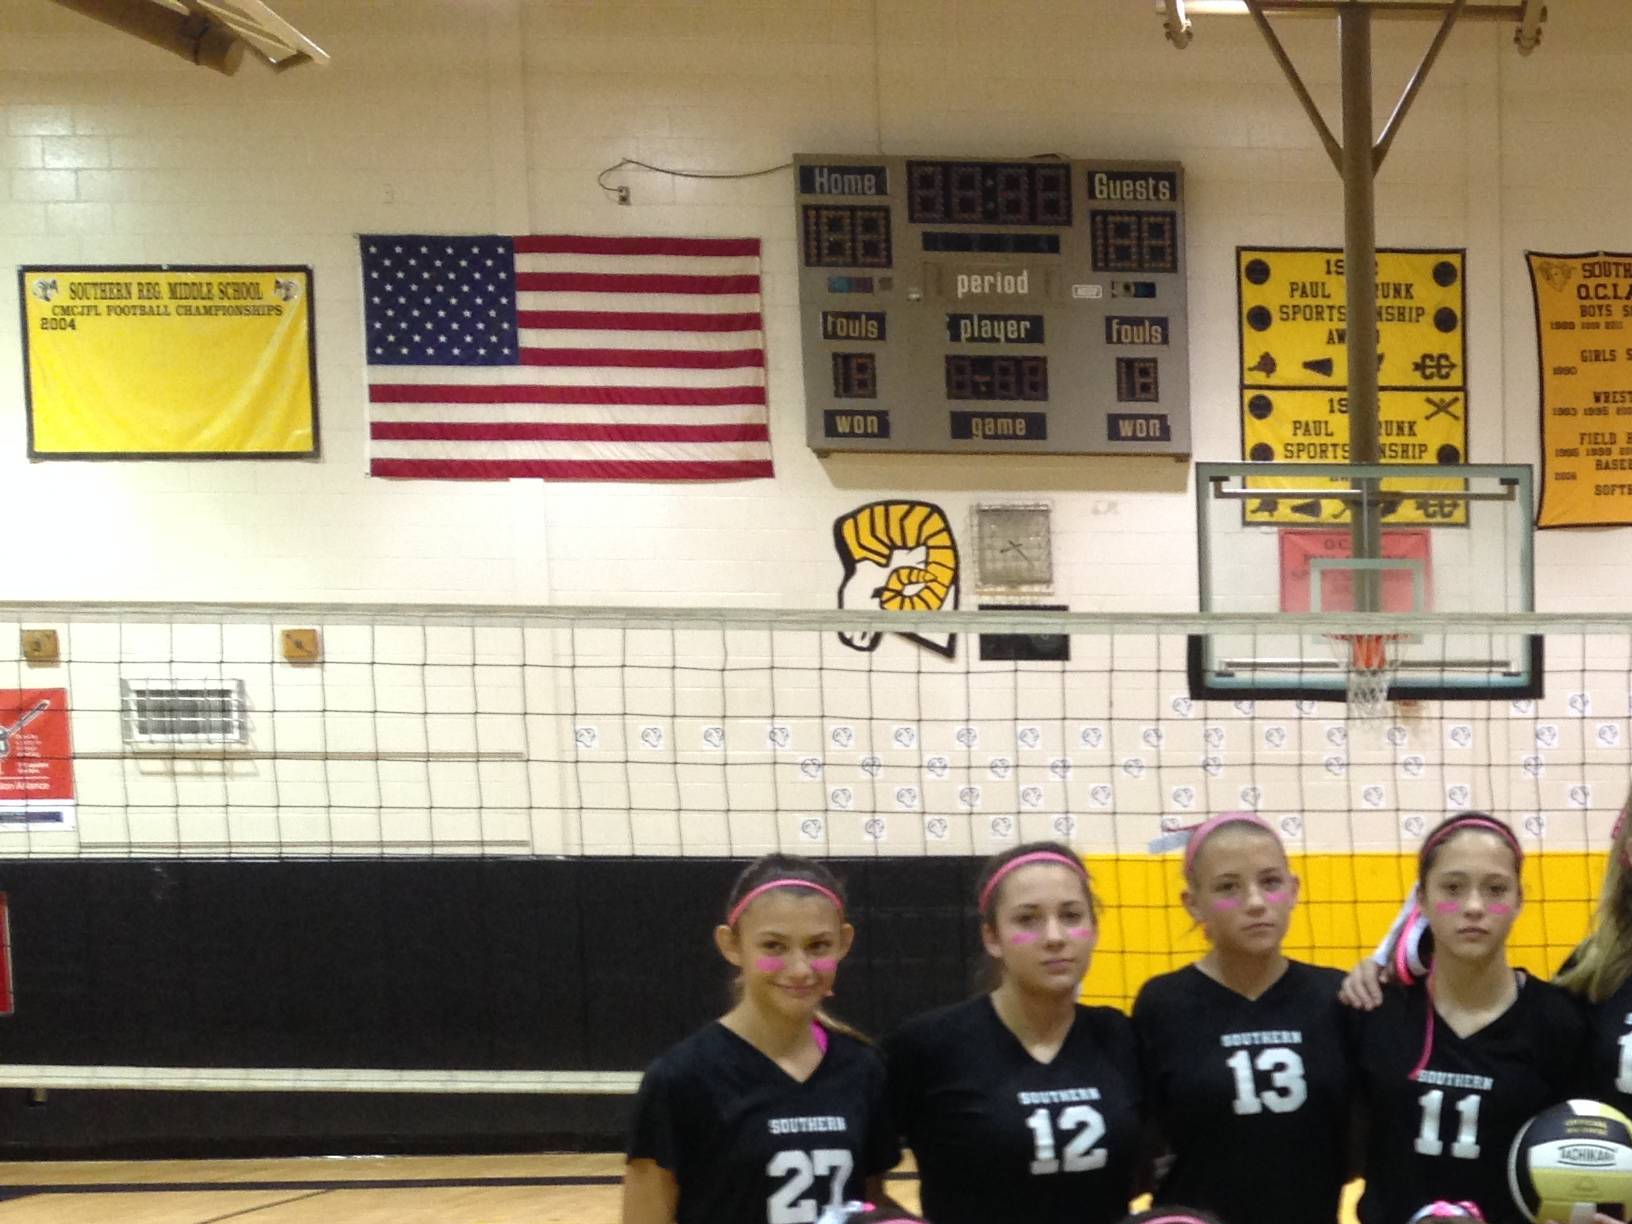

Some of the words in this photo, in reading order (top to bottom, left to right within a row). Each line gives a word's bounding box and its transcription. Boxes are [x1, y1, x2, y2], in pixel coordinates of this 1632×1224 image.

[813, 167, 877, 195] Home
[1094, 173, 1171, 200] Guests
[69, 281, 132, 300] SOUTHERN
[168, 282, 213, 299] MIDDLE
[218, 282, 263, 300] SCHOOL
[956, 270, 1029, 297] period
[1289, 282, 1331, 298] PAUL
[107, 304, 170, 316] FOOTBALL
[176, 304, 283, 316] CHAMPIONSHIPS
[1580, 304, 1613, 317] BOYS
[40, 318, 76, 331] 2004
[959, 316, 1031, 342] player
[1111, 319, 1162, 344] fouls
[1581, 349, 1616, 362] GIRLS
[835, 413, 879, 434] won
[971, 416, 1027, 438] game
[1119, 417, 1161, 437] won
[1292, 420, 1334, 437] PAUL
[1579, 432, 1617, 445] FIELD
[1221, 1030, 1303, 1047] SOUTHERN
[1226, 1047, 1307, 1115] 13
[1417, 1068, 1494, 1091] SOUTHERN
[1017, 1087, 1101, 1106] SOUTHERN
[768, 1116, 847, 1134] SOUTHERN
[1414, 1090, 1481, 1159] 11
[1026, 1104, 1108, 1174] 12
